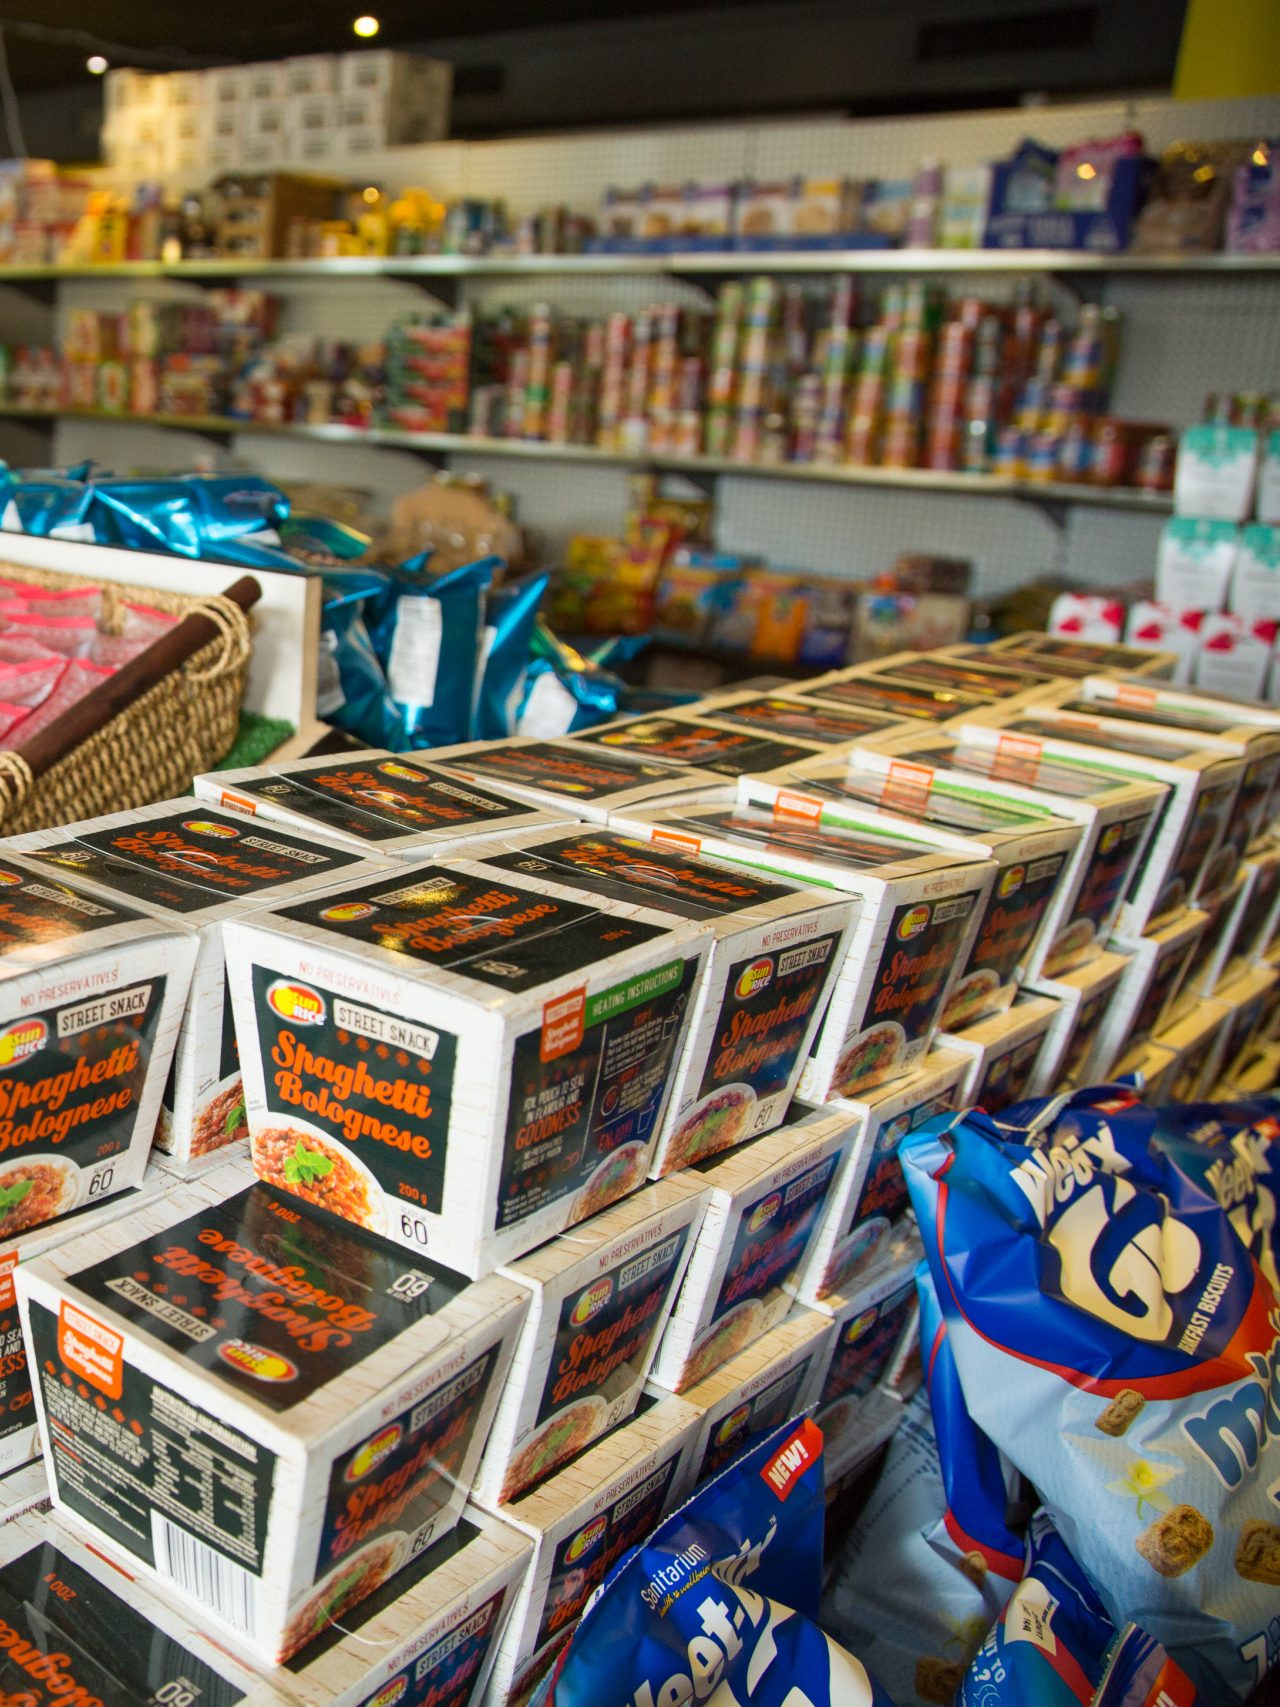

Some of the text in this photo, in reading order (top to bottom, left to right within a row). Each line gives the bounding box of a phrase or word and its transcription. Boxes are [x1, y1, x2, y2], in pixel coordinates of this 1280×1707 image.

[245, 837, 321, 862] STREET SNACK
[28, 885, 104, 915] STREET SNACK
[762, 921, 818, 947] NO PRESERVATIVES
[752, 967, 769, 980] Sun
[780, 944, 829, 972] STREET SNACK
[20, 970, 118, 1008] NO PRESERVATIVES
[292, 992, 319, 1010] Sun
[299, 961, 400, 1004] NO PRESERVATIVES
[593, 966, 679, 1016] HEATING INSTRUCTIONS
[62, 992, 146, 1031] STREET SNACK
[339, 1007, 432, 1053] STREET SNACK
[721, 987, 817, 1048] Spaghetti
[12, 1027, 41, 1044] Sun
[713, 1031, 800, 1079] Bolognese
[272, 1030, 432, 1120] Spaghetti
[275, 1071, 432, 1159] Bolognese
[515, 1101, 583, 1150] GOODNESS
[754, 1105, 773, 1129] 60
[88, 1168, 114, 1196] 60
[399, 1182, 419, 1199] 200
[276, 1206, 302, 1224] 200
[401, 1214, 429, 1245] 60
[599, 1223, 663, 1270] NO PRESERVATIVES
[622, 1242, 677, 1284] STREET SNACK
[152, 1246, 354, 1352] Spaghetti
[197, 1229, 378, 1332] Bolognese
[391, 1273, 430, 1299] 60
[1197, 1263, 1234, 1314] BISCUITS
[113, 1279, 210, 1339] STREET SNACK
[559, 1286, 665, 1373] Spaghetti
[5, 1341, 21, 1355] AND
[7, 1329, 23, 1343] SEA
[552, 1327, 655, 1405] Bolognese
[413, 1390, 451, 1427] STREET
[606, 1400, 625, 1427] 60
[593, 1457, 657, 1512] NO PRESERVATIVES
[768, 1439, 810, 1490] NEW!
[616, 1466, 669, 1519] STREET SNACK
[411, 1523, 435, 1554] 60
[53, 1580, 77, 1602] 200
[640, 1540, 708, 1610] Sanitarium
[387, 1602, 469, 1673] NO PRESERVATIVES
[420, 1610, 489, 1675] STREET SNACK
